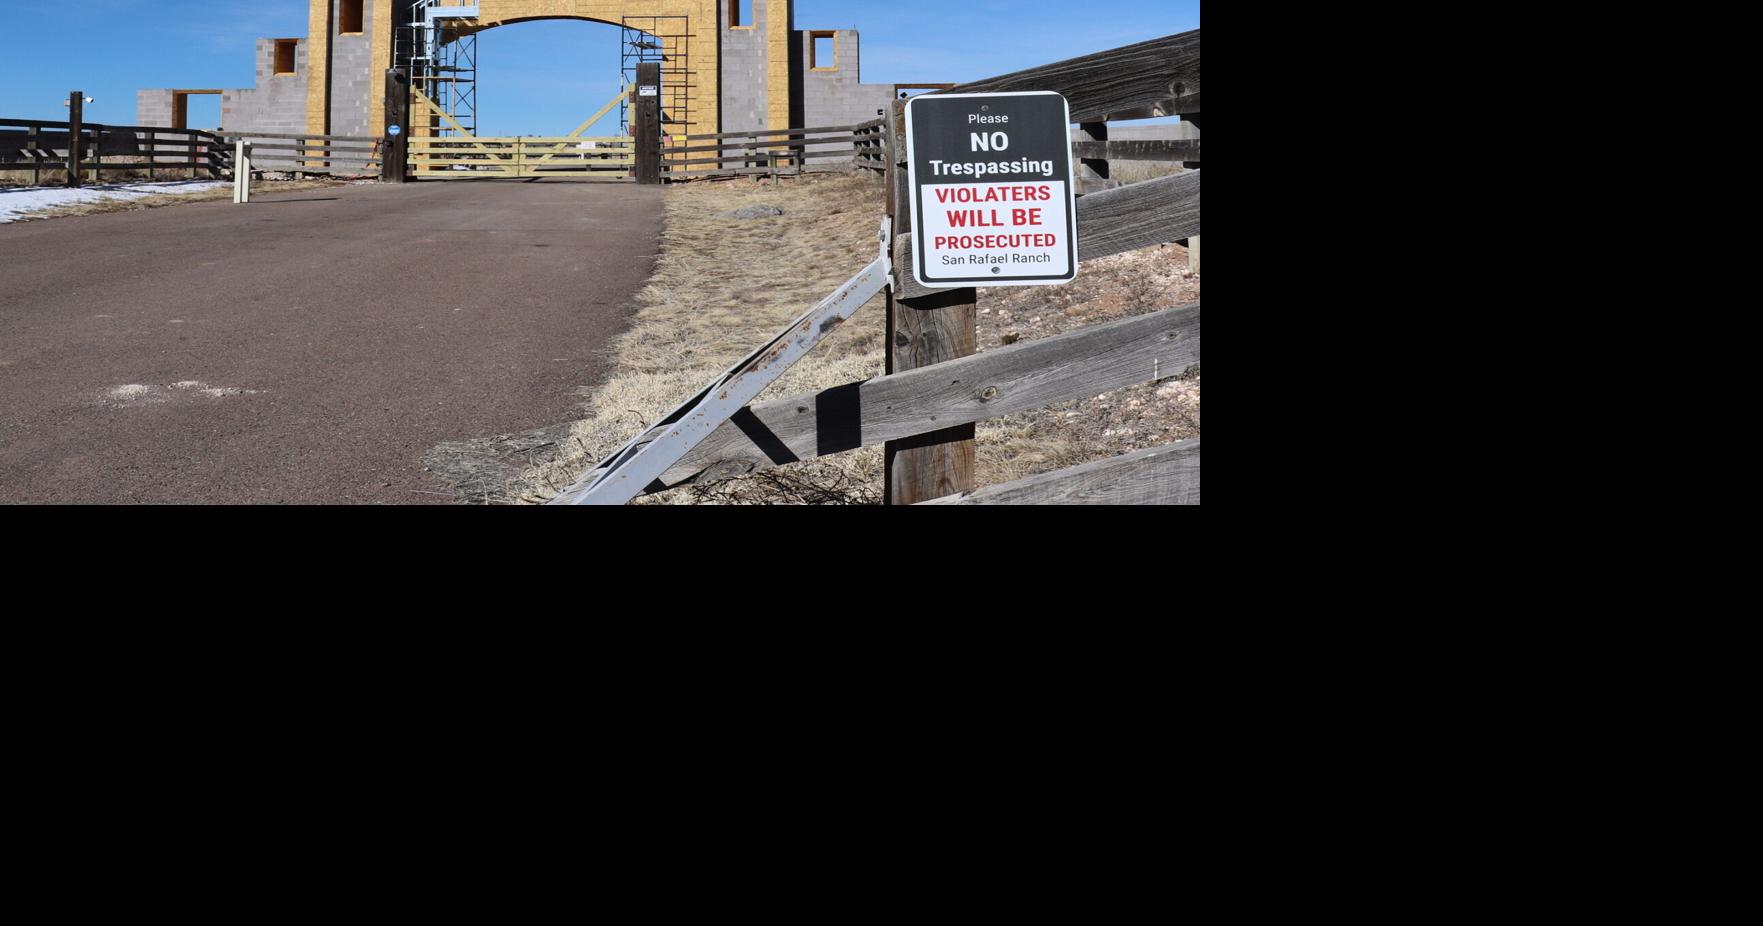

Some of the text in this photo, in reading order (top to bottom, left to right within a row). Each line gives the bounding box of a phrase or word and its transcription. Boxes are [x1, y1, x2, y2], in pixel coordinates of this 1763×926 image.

[968, 114, 1009, 123] Please
[970, 132, 1009, 152] NO
[929, 157, 1053, 178] Trespassing
[935, 186, 1051, 203] VIOLATERS
[947, 208, 1042, 227] WILL BE
[935, 233, 1056, 249] PROSECUTED
[942, 252, 1050, 265] San Rafael Ranch
